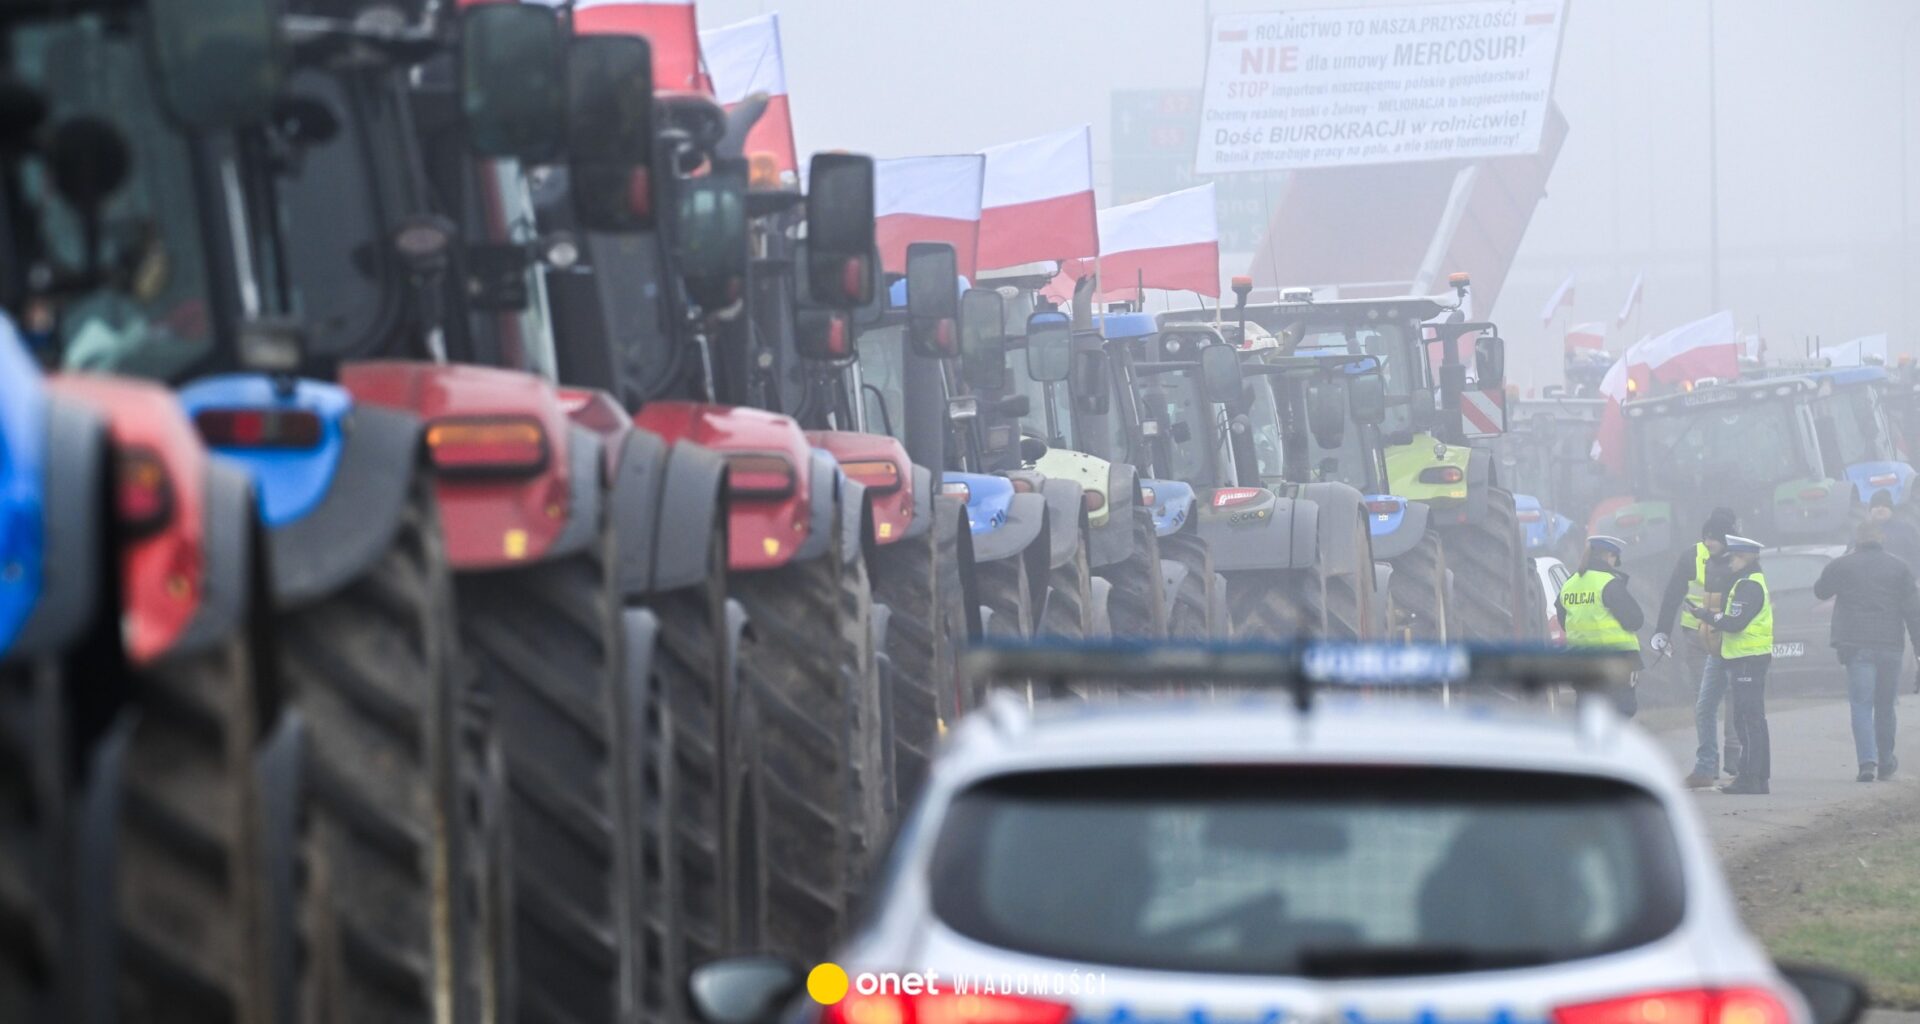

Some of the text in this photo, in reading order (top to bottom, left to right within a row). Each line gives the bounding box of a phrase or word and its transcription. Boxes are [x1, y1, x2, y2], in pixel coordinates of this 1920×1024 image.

[1256, 20, 1342, 41] ROLNICTWO
[1347, 19, 1365, 37] TO
[1240, 34, 1526, 75] NIE dla umowy MERCOSUR!
[1227, 79, 1269, 99] STOP
[1331, 78, 1401, 96] niszczącemu
[1403, 75, 1445, 95] polskie
[1449, 67, 1530, 89] gospodarstwa!
[1206, 107, 1247, 122] Chcemy
[1250, 105, 1288, 121] realnej
[1377, 96, 1445, 113] MELIORACJA
[1460, 88, 1545, 109] bezpieczeństwo!
[1215, 108, 1527, 146] Dość BIUROKRACJI w rolnictwie!
[1216, 149, 1249, 164] Rolnik
[1252, 147, 1311, 165] potrzebuje
[1313, 145, 1344, 161] pracy
[1404, 140, 1421, 152] nie
[1457, 131, 1520, 149] formularzy!
[1563, 591, 1596, 606] POLICJA
